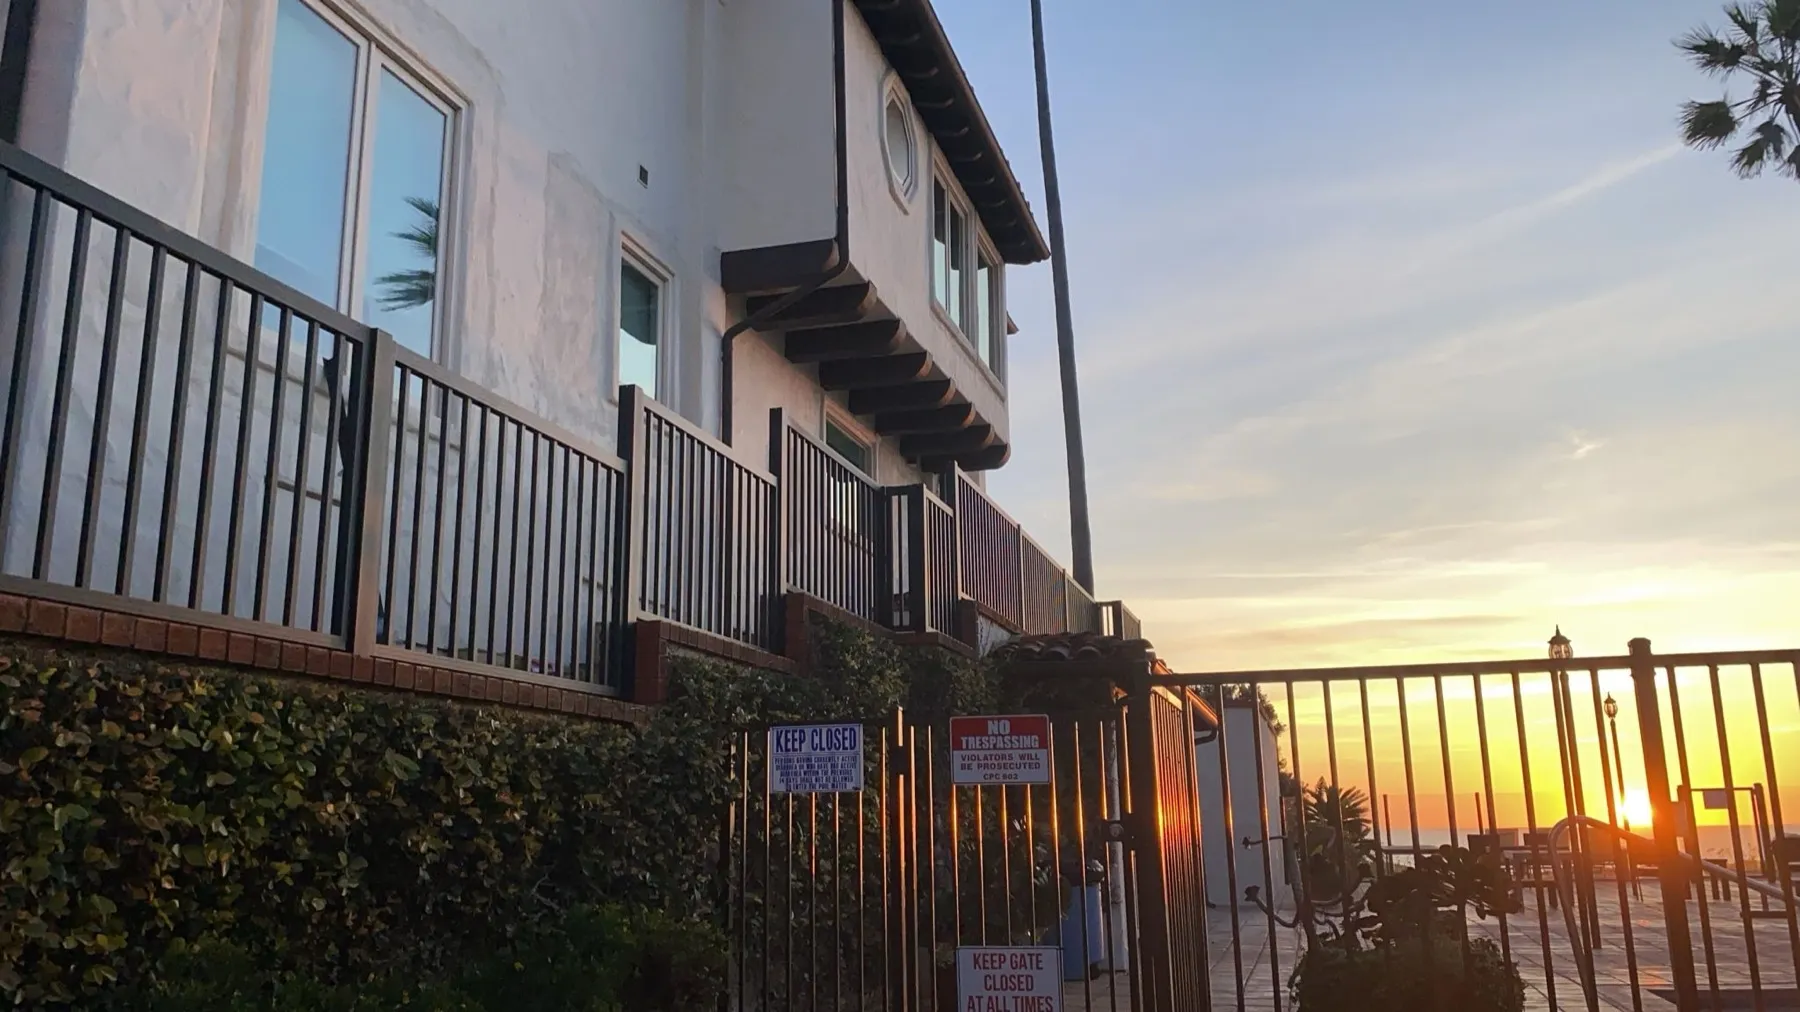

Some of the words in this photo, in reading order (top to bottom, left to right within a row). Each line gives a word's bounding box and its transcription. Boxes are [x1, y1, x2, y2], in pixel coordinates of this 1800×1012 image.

[988, 720, 1010, 734] NO
[776, 729, 806, 752] KEEP
[811, 727, 856, 751] CLOSED
[961, 736, 1039, 749] TRESPASSING
[977, 762, 1040, 770] PROSECUTED
[973, 953, 1006, 970] KEEP
[1010, 953, 1043, 970] GATE
[984, 975, 1034, 991] CLOSED
[967, 996, 983, 1012] AT
[986, 996, 1010, 1012] ALL
[1012, 996, 1053, 1012] TIMES
